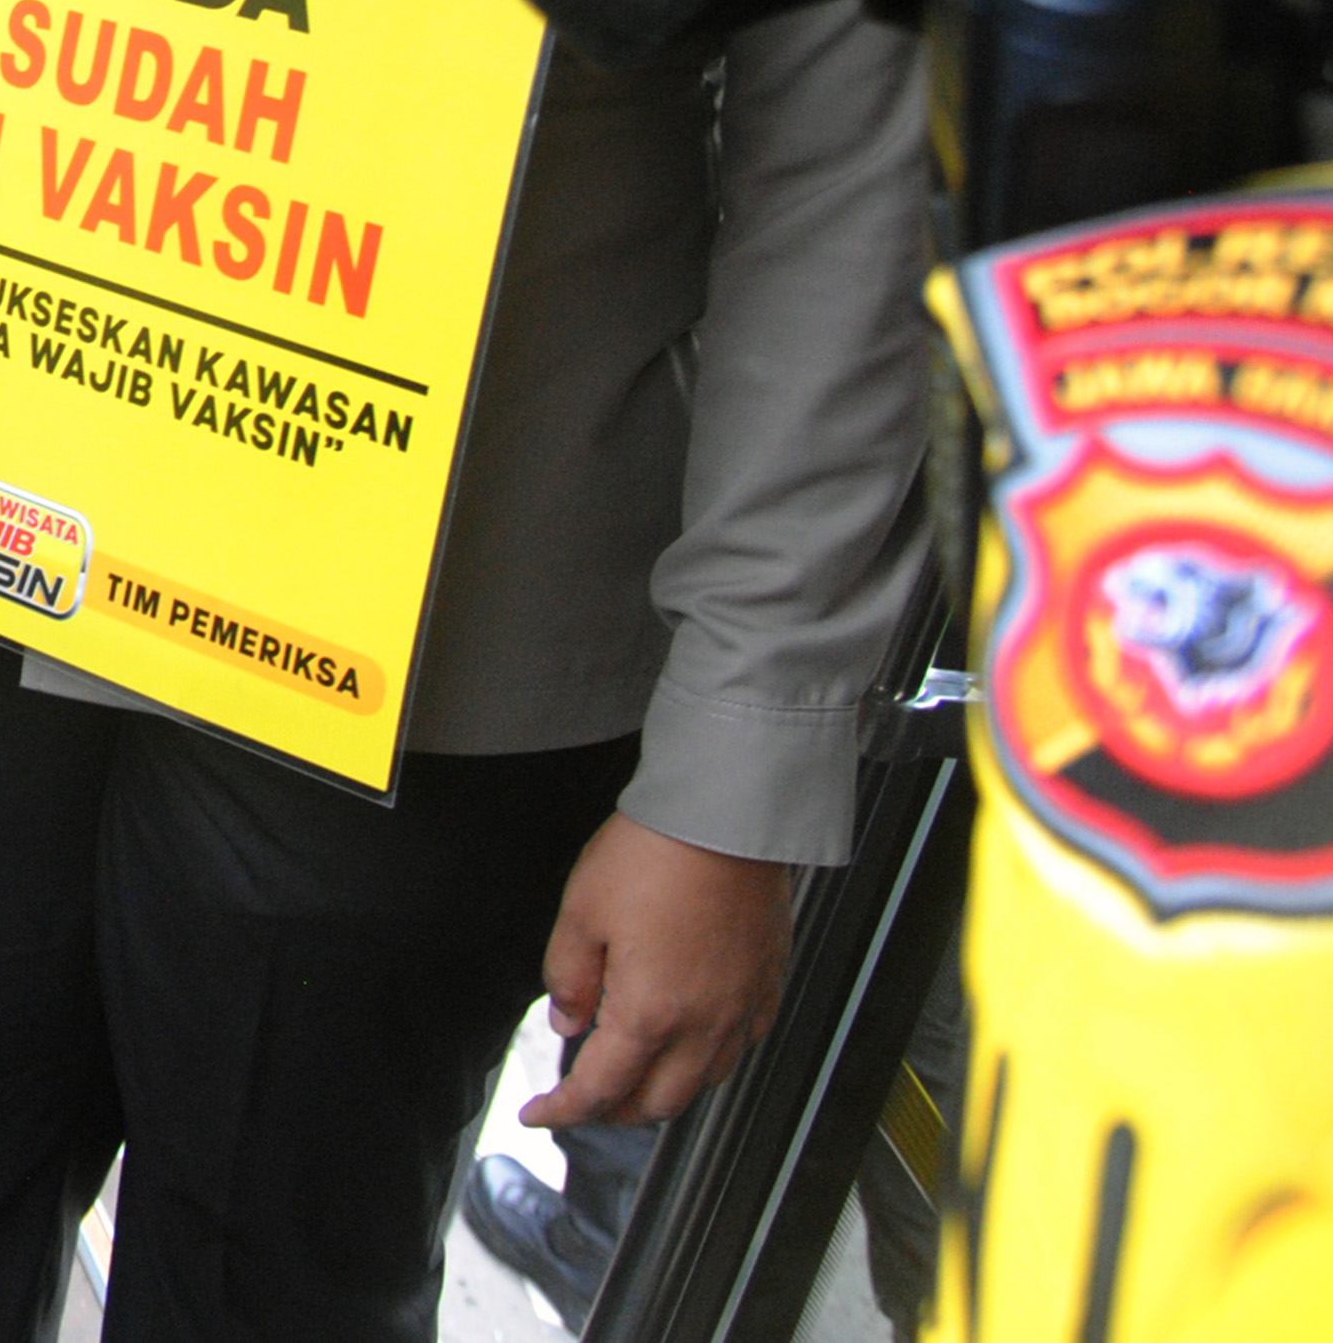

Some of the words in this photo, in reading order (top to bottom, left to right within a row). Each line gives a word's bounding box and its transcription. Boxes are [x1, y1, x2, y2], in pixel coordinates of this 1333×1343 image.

[39, 126, 384, 320] VAKSIN
[30, 332, 153, 407] WAJIB
[194, 345, 413, 453] KAWASAN
[108, 572, 161, 619] TIM
[168, 598, 360, 699] PEMERIKSA
